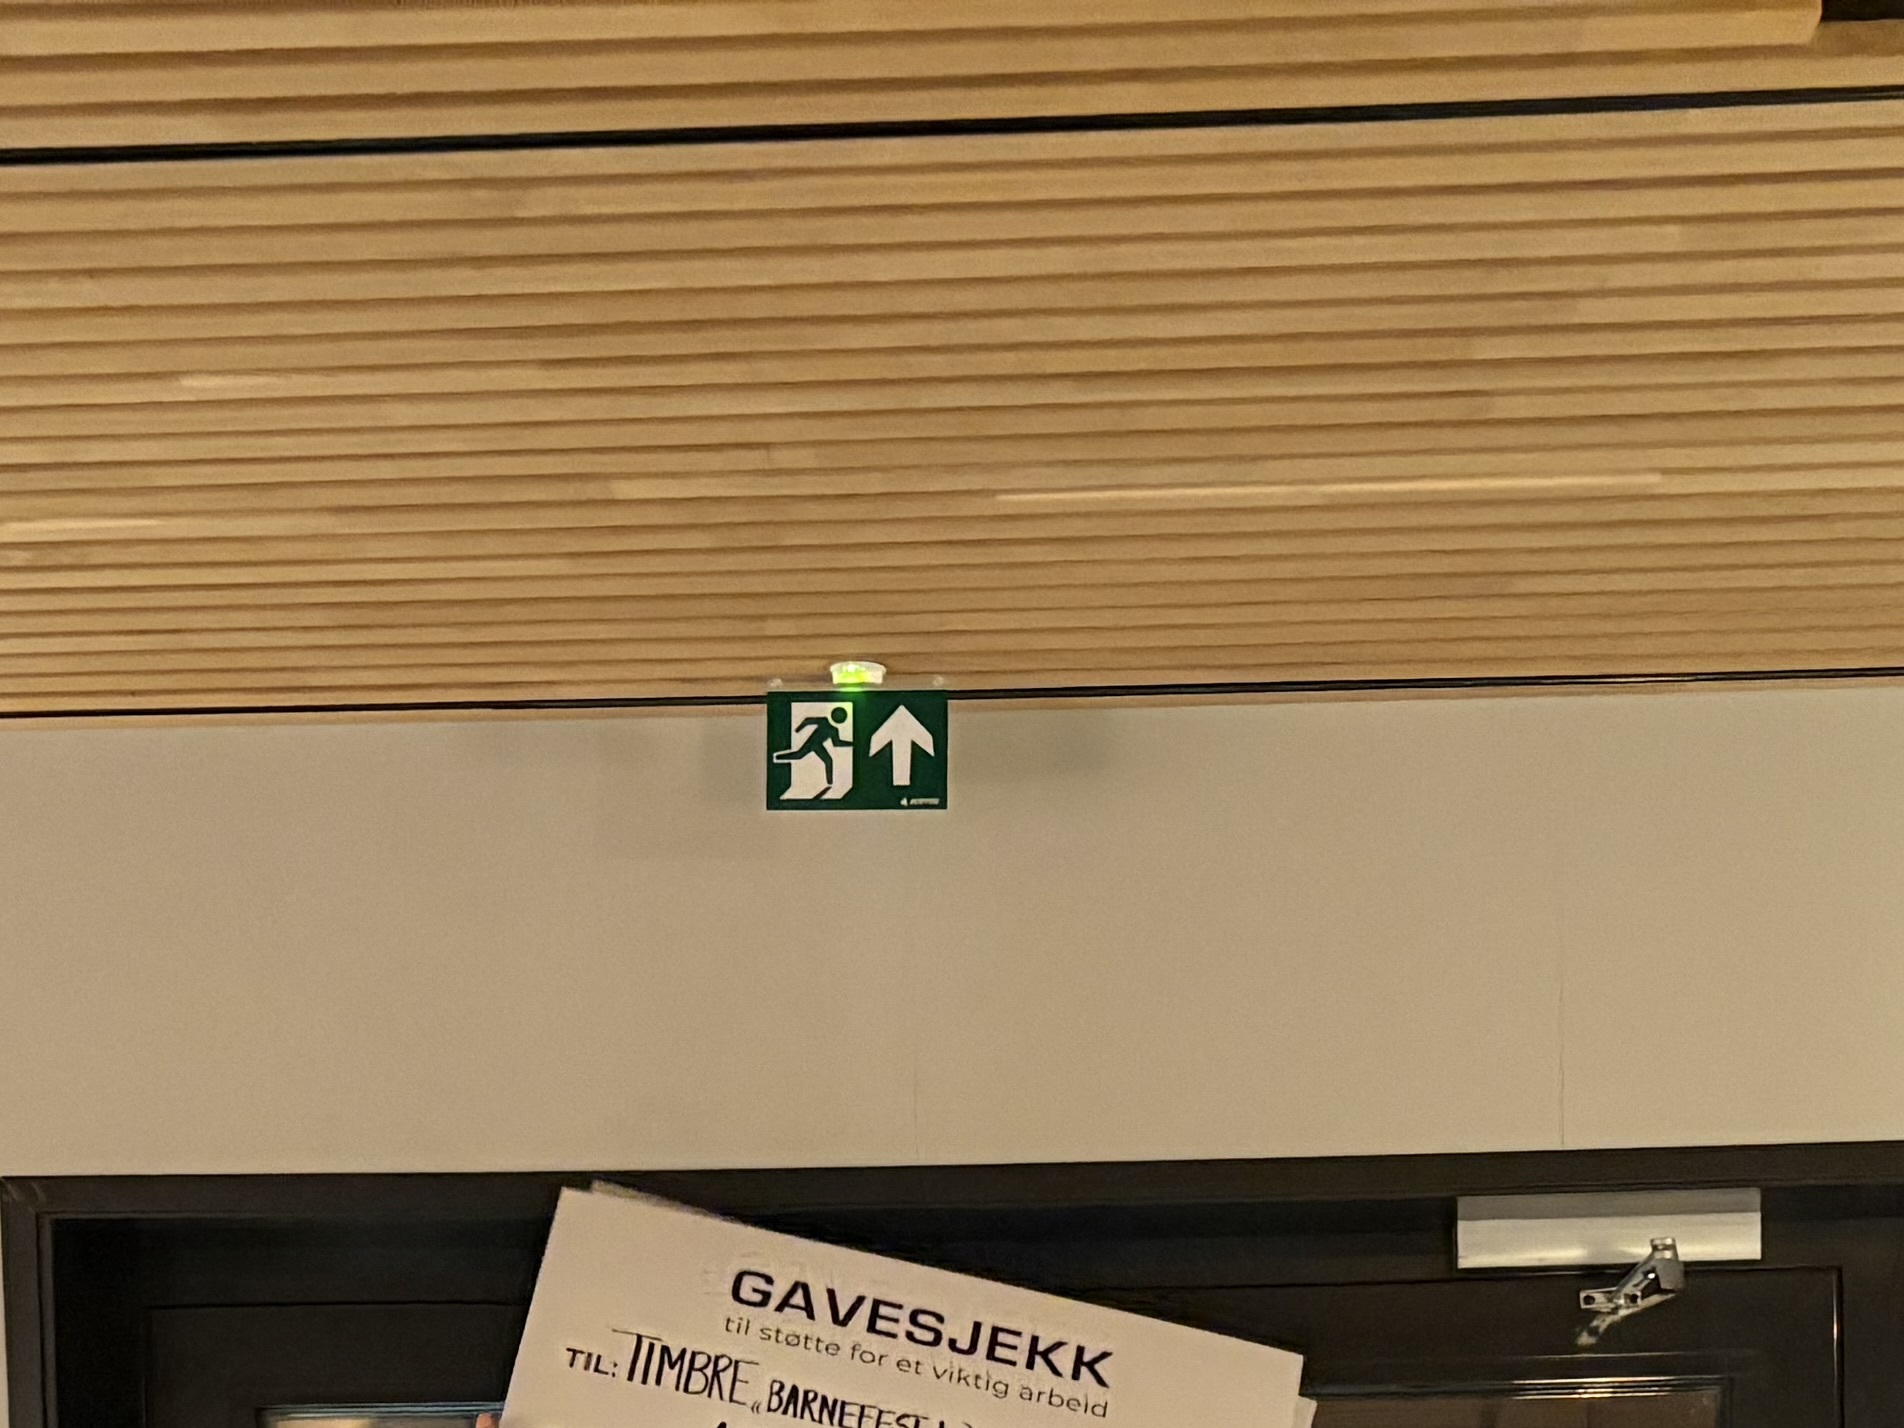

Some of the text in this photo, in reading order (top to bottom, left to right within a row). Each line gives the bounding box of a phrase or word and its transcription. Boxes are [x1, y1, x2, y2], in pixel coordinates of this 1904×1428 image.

[565, 1347, 619, 1378] TIL:
[612, 1328, 757, 1406] TIMBRE
[725, 1316, 1109, 1419] til støtte for et viktig arbeid
[730, 1268, 1115, 1390] GAVESJEKK
